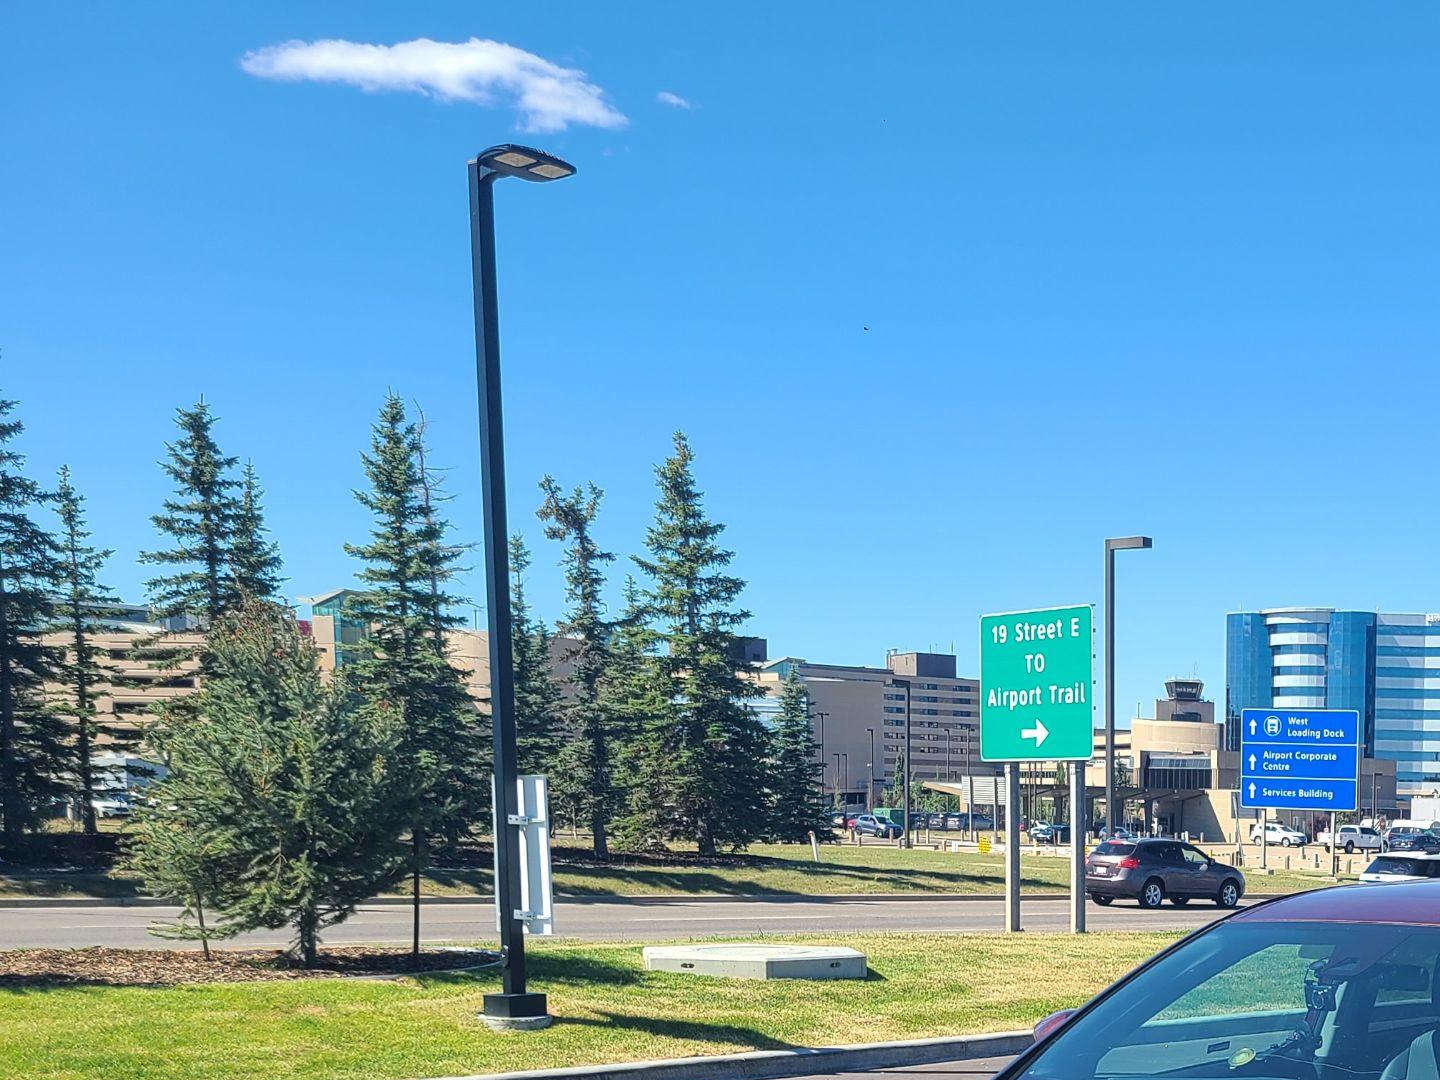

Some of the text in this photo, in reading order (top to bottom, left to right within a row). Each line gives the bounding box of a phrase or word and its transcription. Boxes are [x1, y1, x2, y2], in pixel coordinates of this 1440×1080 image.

[991, 617, 1080, 644] 19 Street E
[1025, 653, 1045, 674] TO
[987, 681, 1086, 711] Airport Trail
[1287, 716, 1309, 726] West
[1287, 728, 1345, 739] Loading Dock
[1262, 750, 1337, 762] Airport Corporate
[1262, 761, 1290, 771] Centre
[1262, 787, 1334, 801] Services Building
